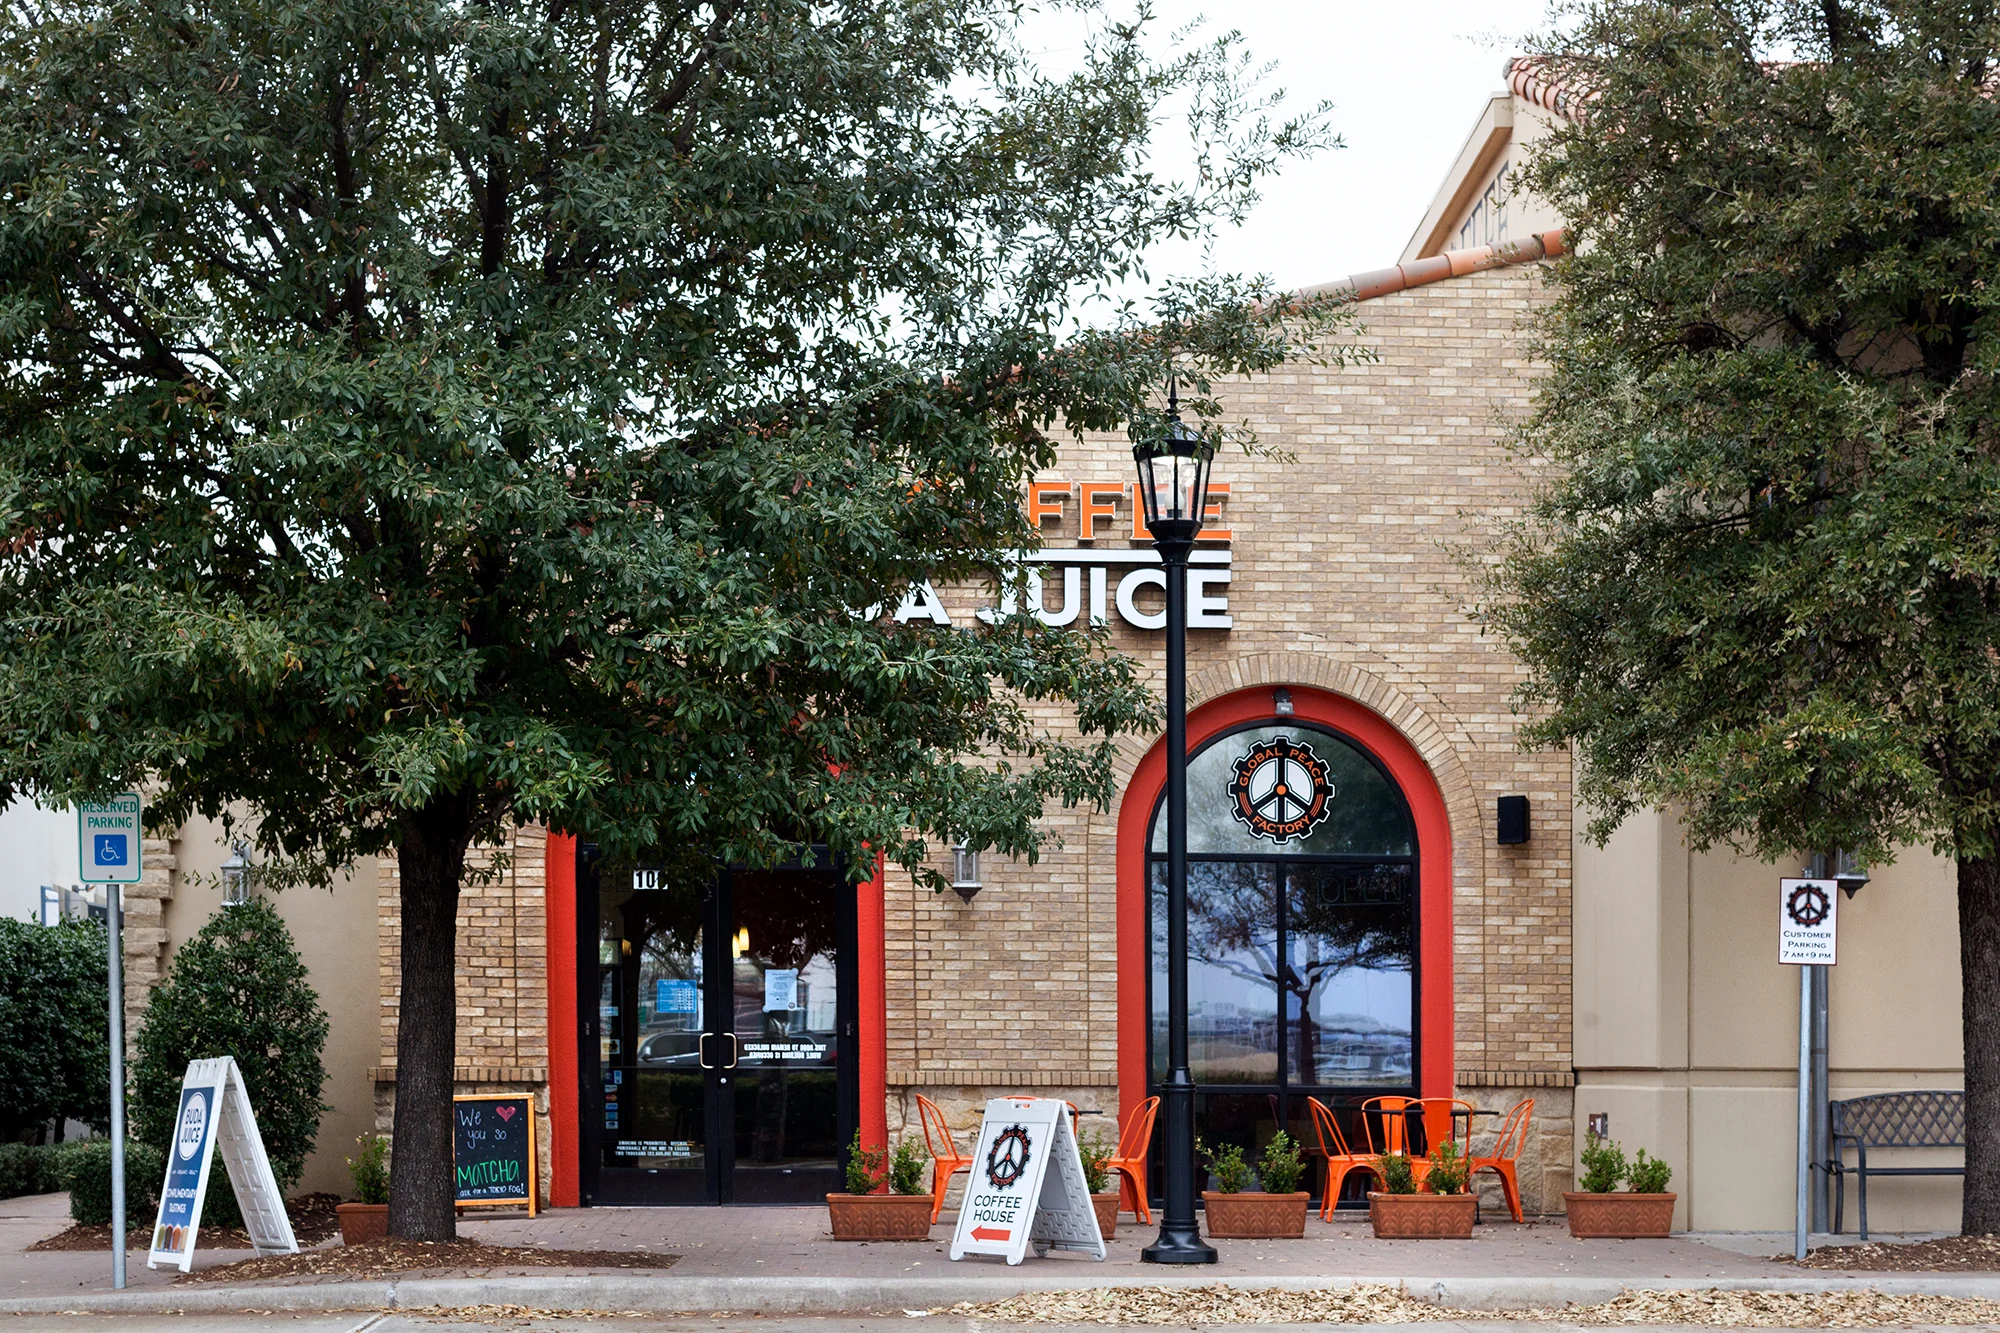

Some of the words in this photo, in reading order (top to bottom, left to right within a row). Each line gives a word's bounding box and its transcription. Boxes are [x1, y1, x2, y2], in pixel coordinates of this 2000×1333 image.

[905, 479, 1233, 543] FFEE
[975, 566, 1233, 629] JUICE
[1239, 747, 1283, 787] GLOBAL
[1289, 748, 1325, 787] PEACE
[87, 817, 133, 829] PARKING
[1252, 814, 1311, 834] FACTORY
[635, 870, 668, 889] 10
[185, 1108, 204, 1124] BUDA
[459, 1108, 482, 1127] We
[181, 1127, 201, 1143] JUICE
[467, 1130, 486, 1149] you
[973, 1194, 1023, 1209] COFFEE
[973, 1209, 1016, 1223] HOUSE
